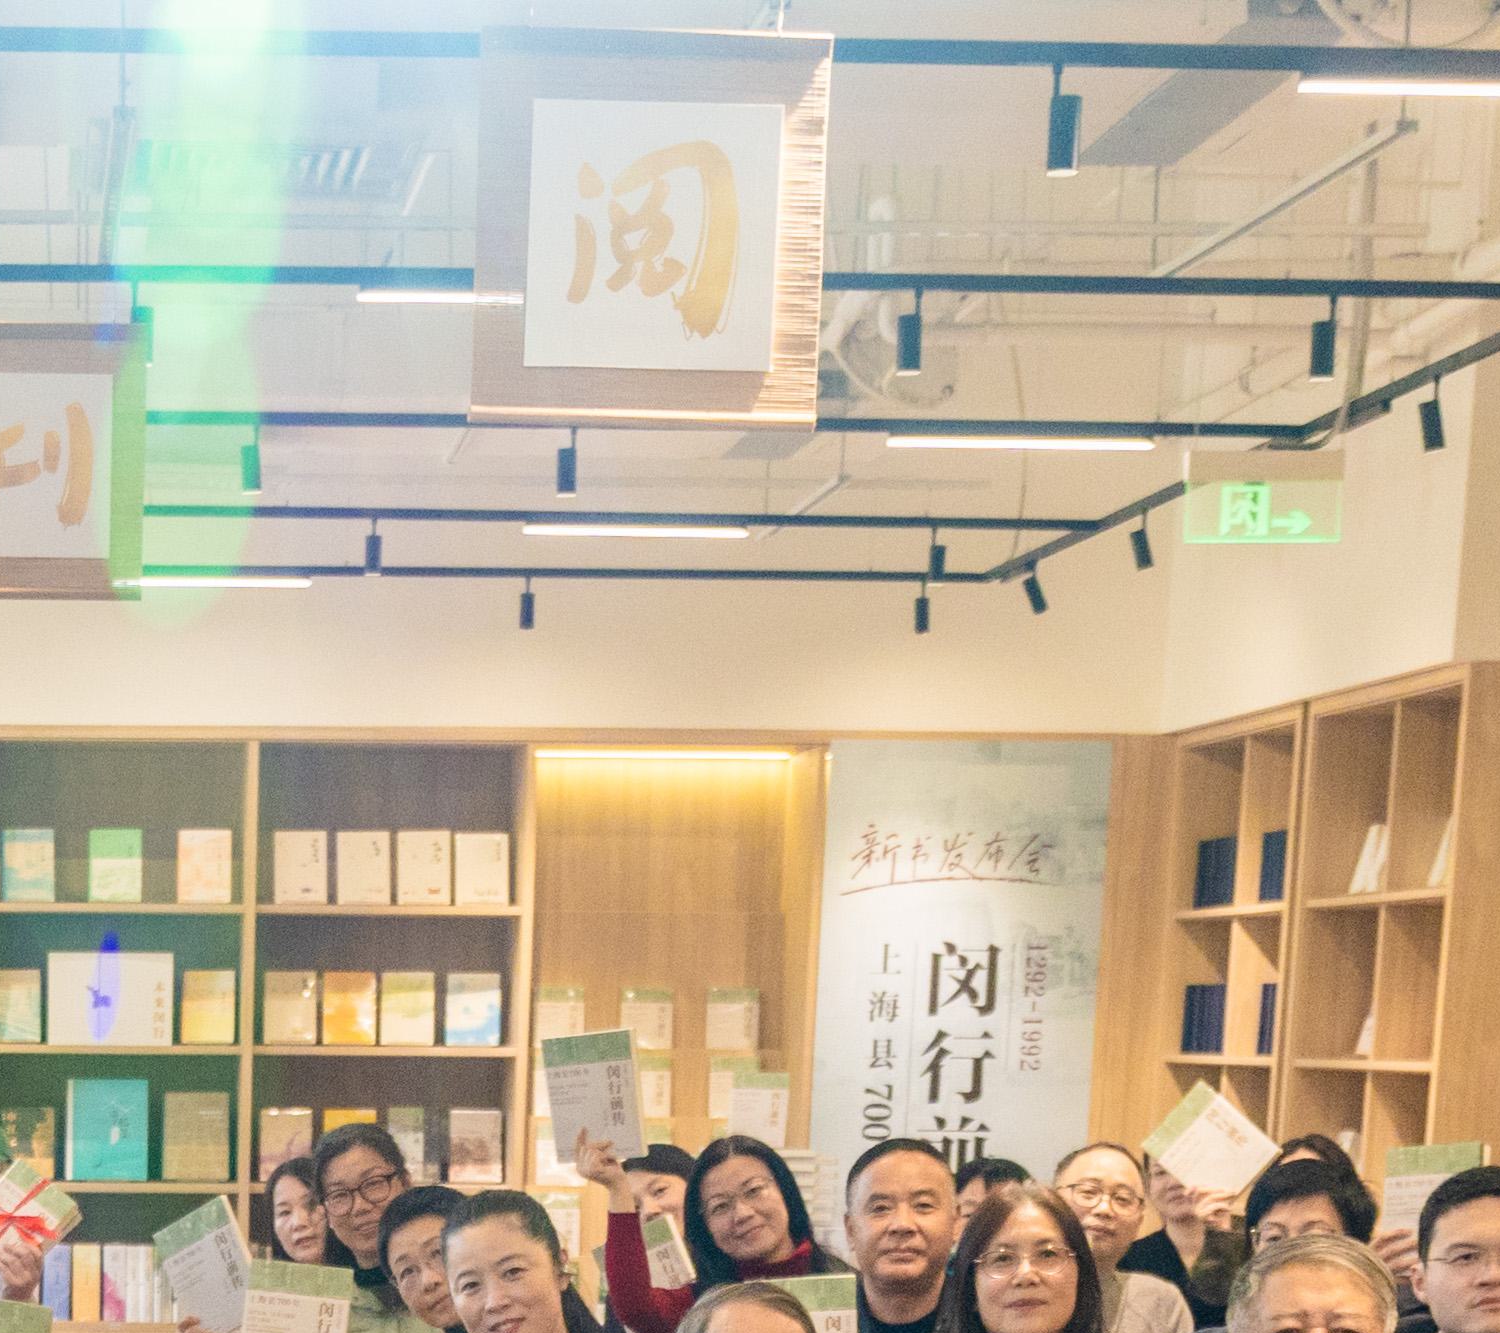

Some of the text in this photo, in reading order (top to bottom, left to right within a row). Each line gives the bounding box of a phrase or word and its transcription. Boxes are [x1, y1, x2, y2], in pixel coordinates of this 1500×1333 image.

[848, 824, 1055, 885] 新书发布会
[1021, 942, 1048, 1072] 1292-1992
